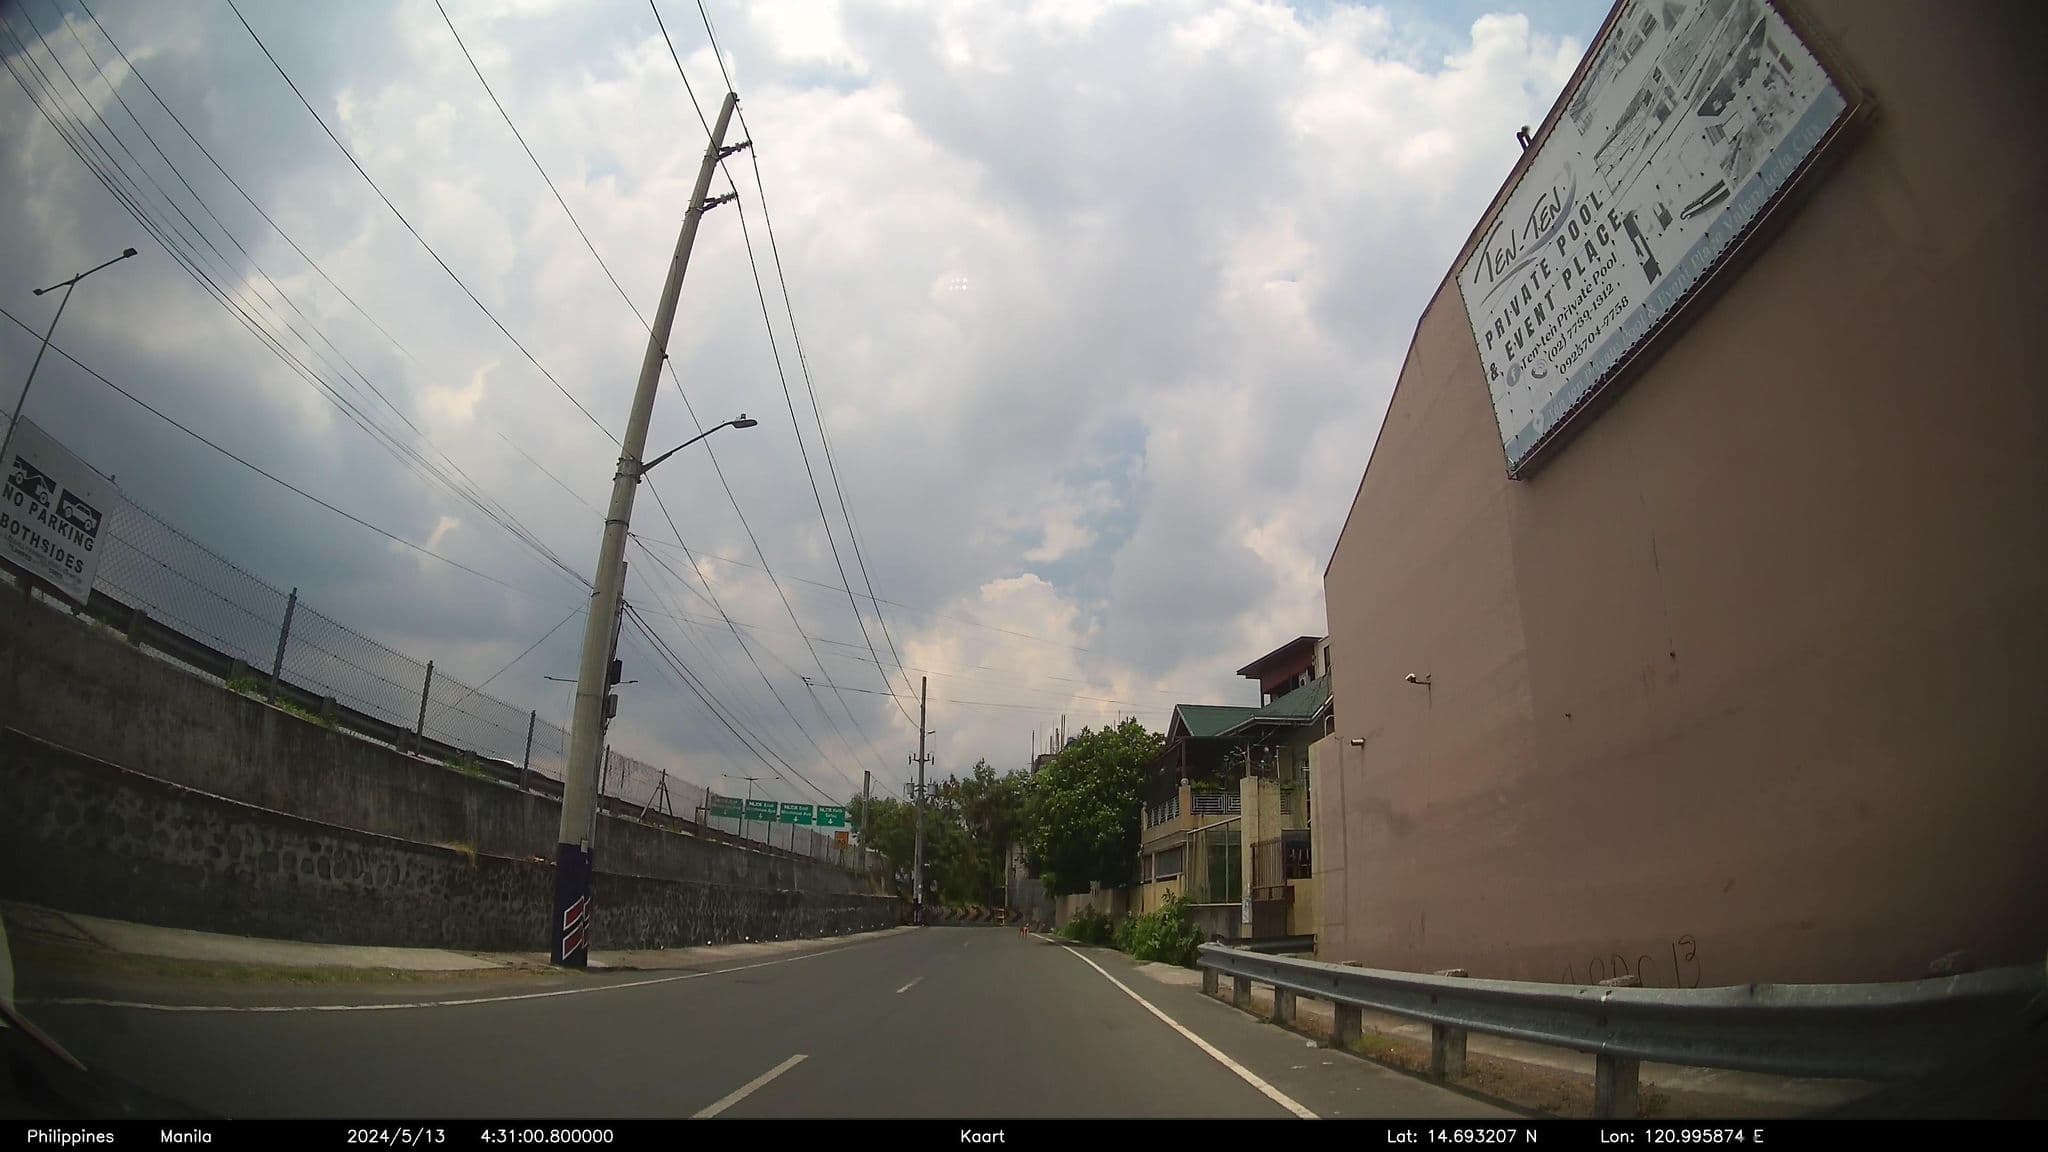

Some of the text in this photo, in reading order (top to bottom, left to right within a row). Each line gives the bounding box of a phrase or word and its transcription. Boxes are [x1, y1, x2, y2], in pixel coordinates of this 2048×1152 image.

[1485, 191, 1604, 351] PRIVATE POOL
[1489, 208, 1622, 381] & EVENT PLACE
[1556, 283, 1592, 327] Private
[1592, 252, 1618, 286] Pool
[1547, 334, 1567, 362] (02)
[0, 511, 84, 574] BOTHSIDES
[3, 483, 94, 552] NO PARKING
